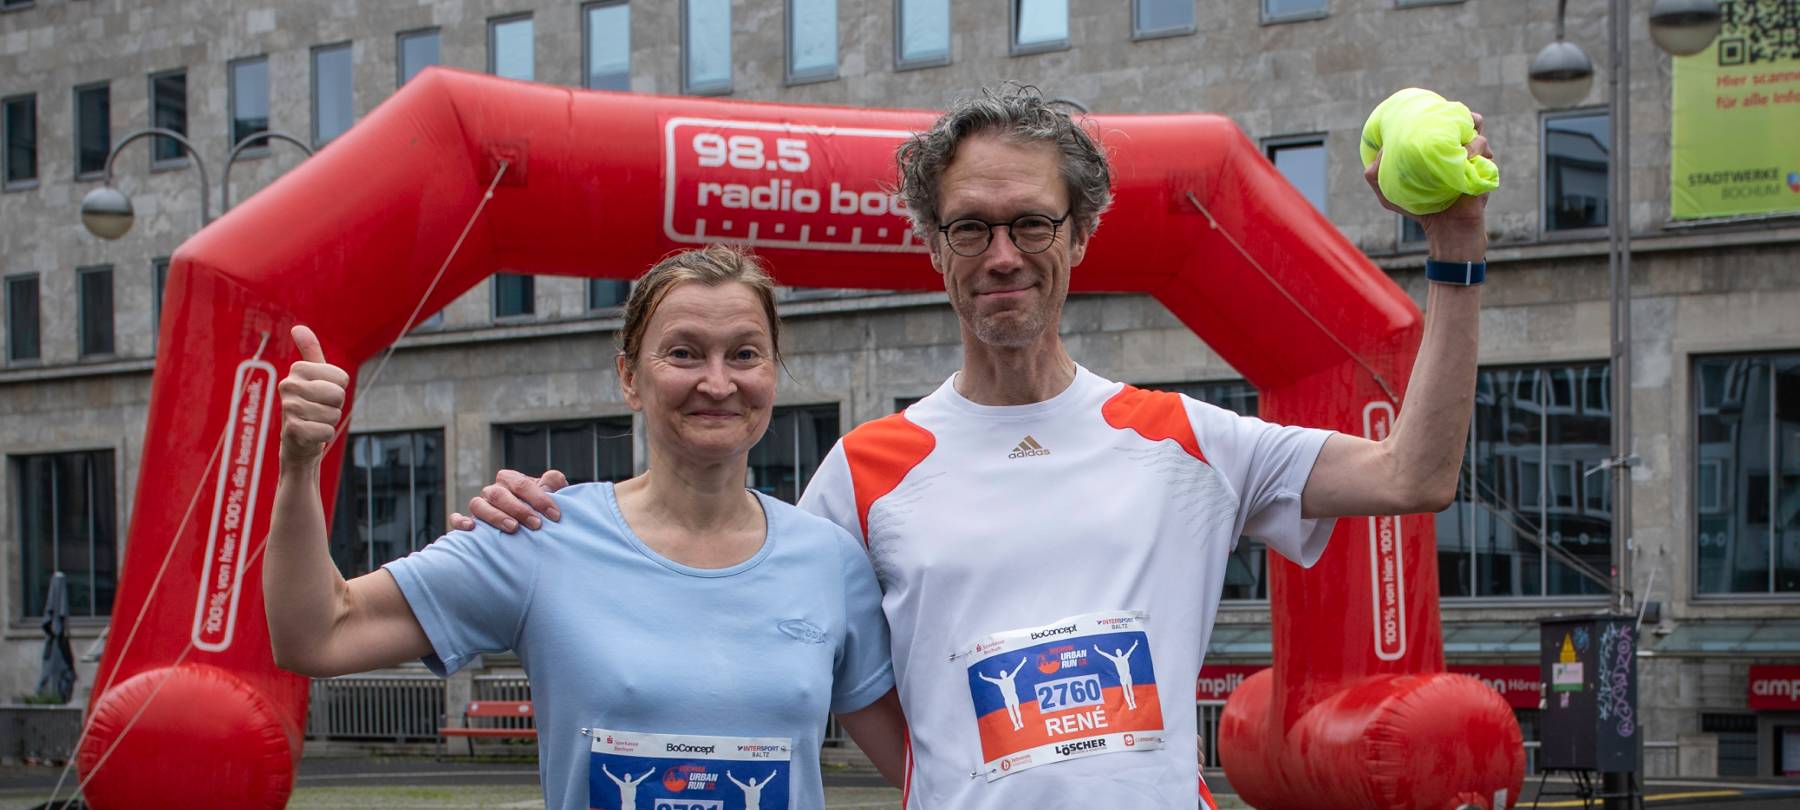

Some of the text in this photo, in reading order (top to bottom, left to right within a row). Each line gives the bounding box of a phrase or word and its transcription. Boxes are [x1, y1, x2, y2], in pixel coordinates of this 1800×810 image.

[1716, 75, 1746, 88] Hier
[1743, 91, 1768, 107] alle
[693, 133, 811, 173] 98.5
[1688, 168, 1779, 186] STADTWERKE
[697, 178, 821, 212] radio
[1721, 184, 1780, 200] BOCHUM
[1008, 448, 1051, 460] adidas
[207, 378, 263, 634] 100% von hier. 100% die beste Musik.
[1382, 555, 1394, 582] hier.
[1385, 583, 1395, 606] von
[1030, 624, 1077, 640] BoConcept
[1384, 607, 1397, 646] 100%
[1060, 649, 1088, 661] URBAN
[1061, 659, 1078, 669] RUN
[1038, 679, 1100, 710] 2760
[1045, 707, 1108, 736] RENÉ
[666, 743, 715, 755] BoConcept
[1055, 738, 1106, 756] LÖSCHER
[687, 781, 705, 790] RUN
[689, 772, 719, 782] URBAN
